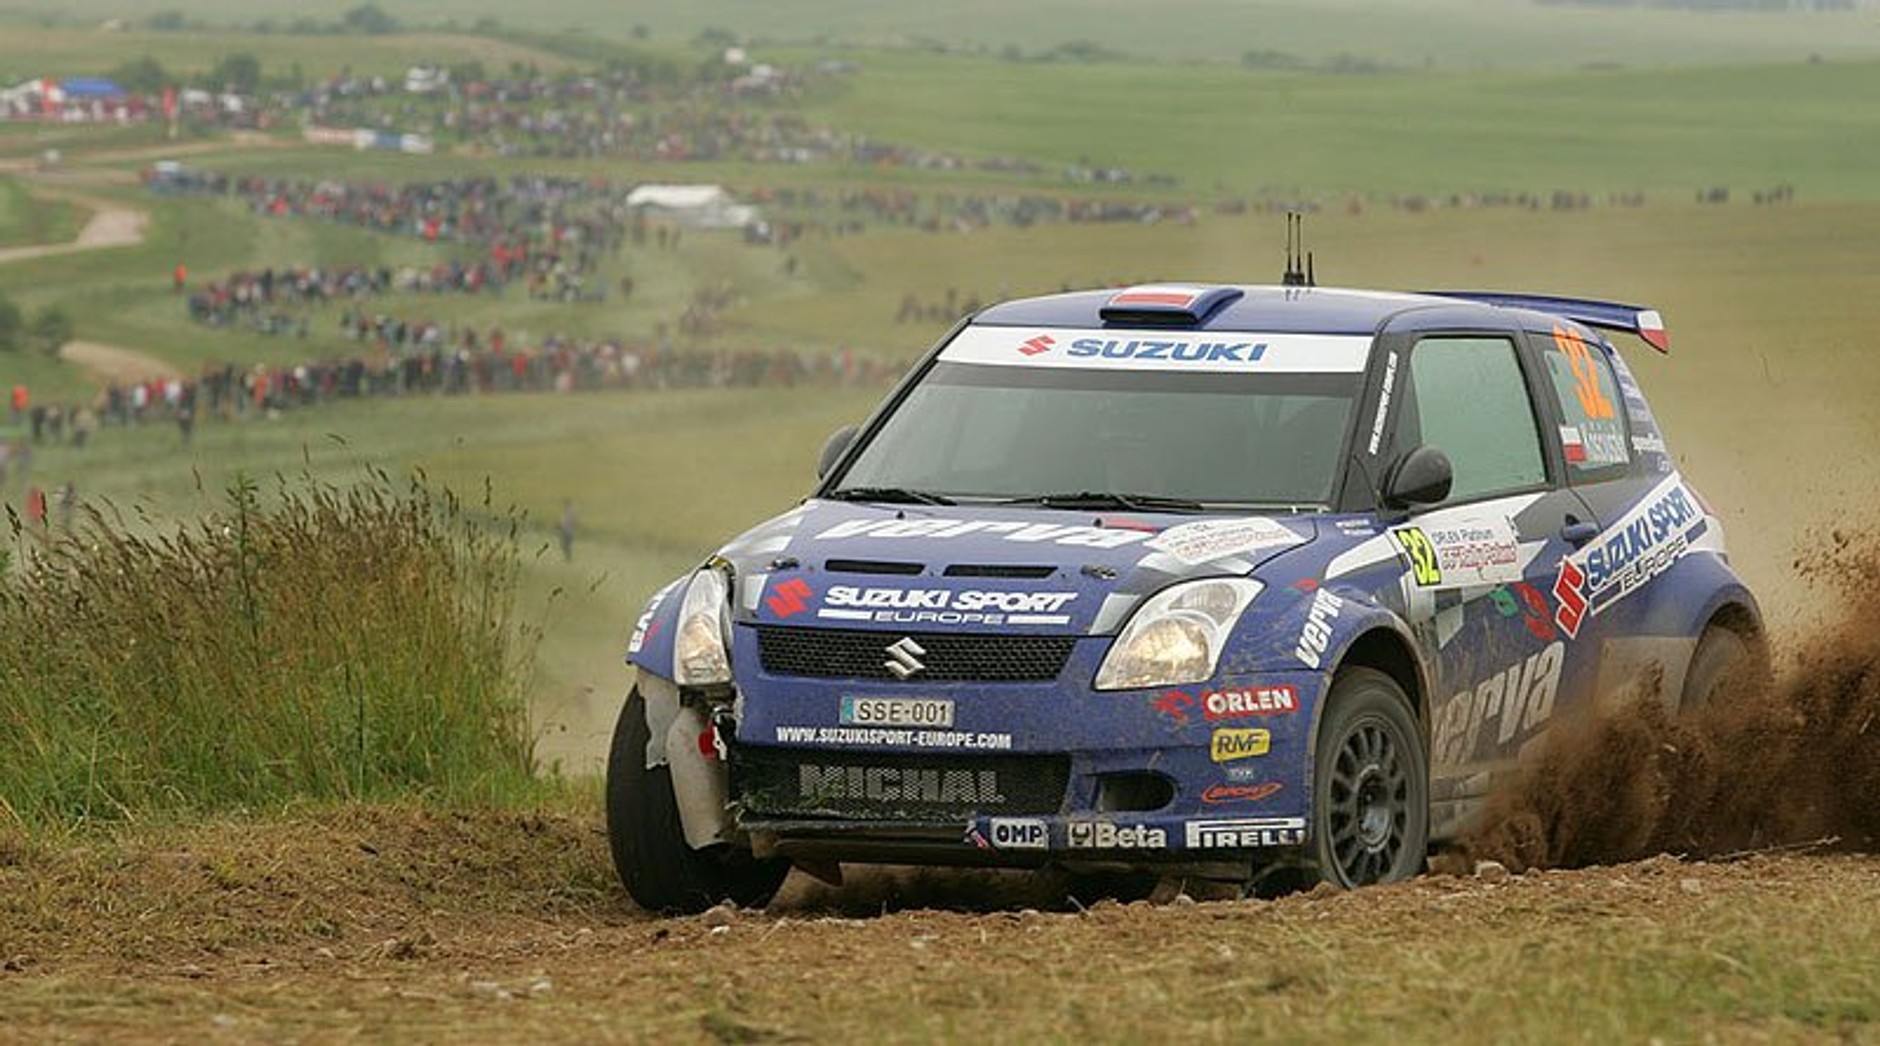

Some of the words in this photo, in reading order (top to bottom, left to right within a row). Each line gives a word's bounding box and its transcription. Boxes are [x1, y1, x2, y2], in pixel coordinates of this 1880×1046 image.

[1067, 338, 1268, 362] SUZUKI
[1552, 321, 1616, 420] 32
[1588, 516, 1653, 588] SUZUKI
[1648, 486, 1696, 543] SPORT
[1398, 528, 1440, 584] 32
[1623, 535, 1687, 590] EUROPE
[825, 586, 948, 609] SUZUKI
[951, 590, 1078, 613] SPORT
[873, 611, 1003, 625] EUROPE
[1295, 587, 1344, 670] verva
[858, 702, 948, 722] SSE-001
[1207, 688, 1294, 714] ORLEN
[776, 726, 1012, 750] WWW.SUZUKISPORT-EUROPE.COM
[1217, 733, 1263, 753] RMF
[800, 763, 1006, 803] MICHAL
[996, 824, 1042, 843] OMP
[1096, 822, 1167, 848] Beta
[1185, 818, 1306, 848] PIRELLI
